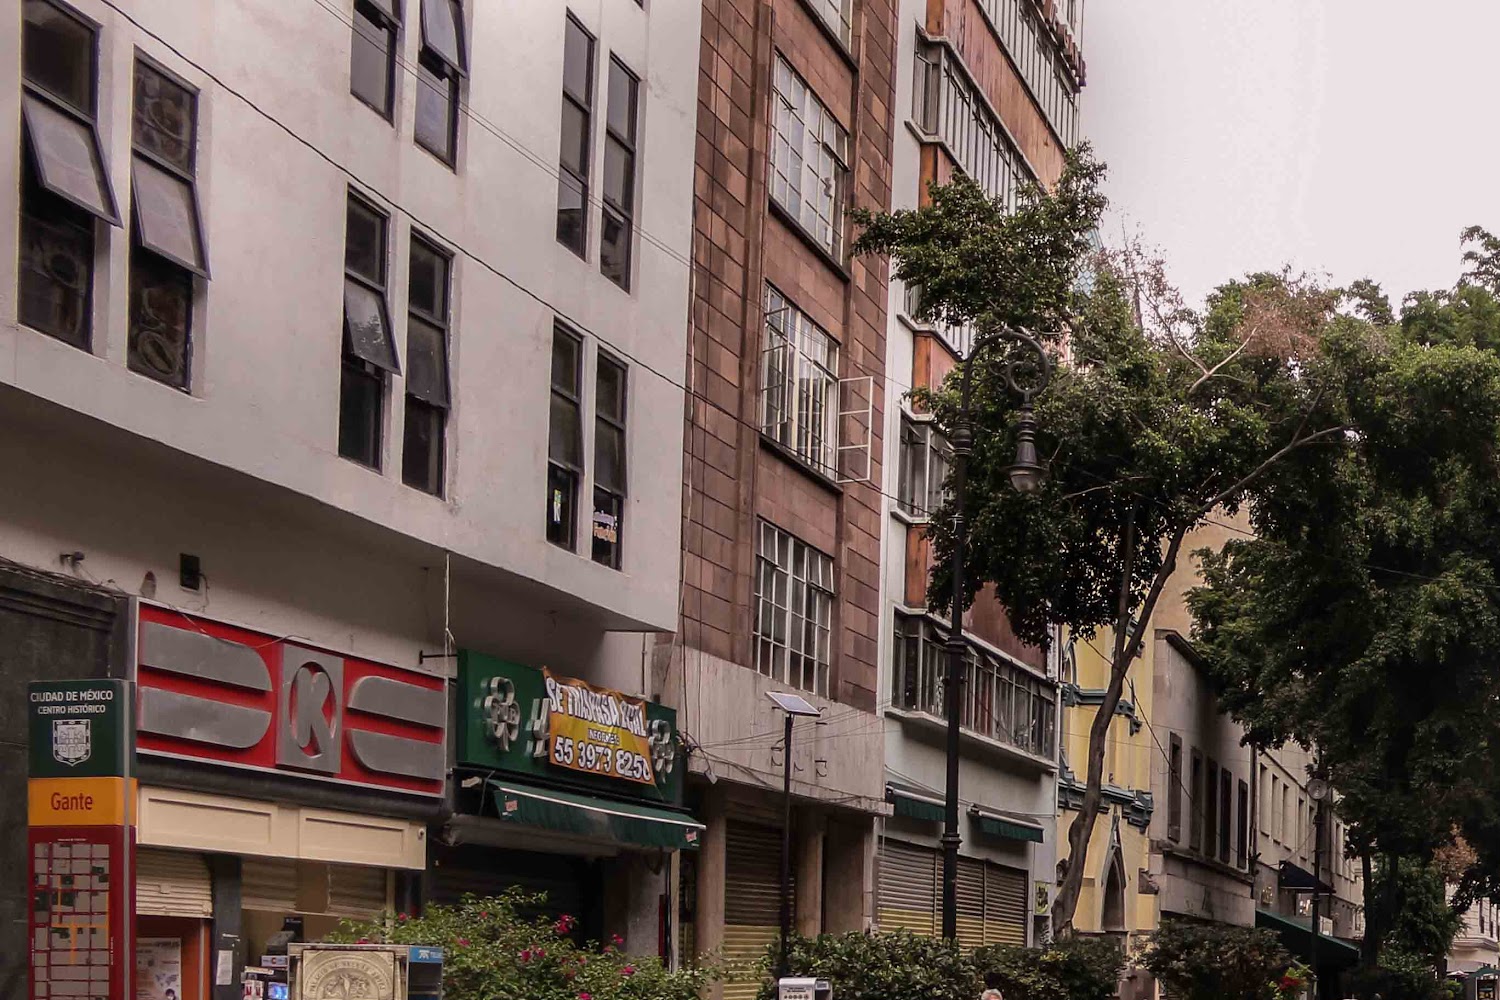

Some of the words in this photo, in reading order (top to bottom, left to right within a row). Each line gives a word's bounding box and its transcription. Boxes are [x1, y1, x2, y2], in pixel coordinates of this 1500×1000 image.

[30, 691, 63, 702] CIUDAD
[66, 692, 77, 702] DE
[79, 689, 113, 701] MÉXICO
[546, 677, 564, 713] SE
[565, 686, 621, 727] TRASPASA
[37, 705, 66, 715] CENTRO
[67, 703, 106, 715] HISTÓRICO
[554, 736, 574, 764] 55
[578, 740, 612, 772] 3973
[51, 792, 93, 811] Gante
